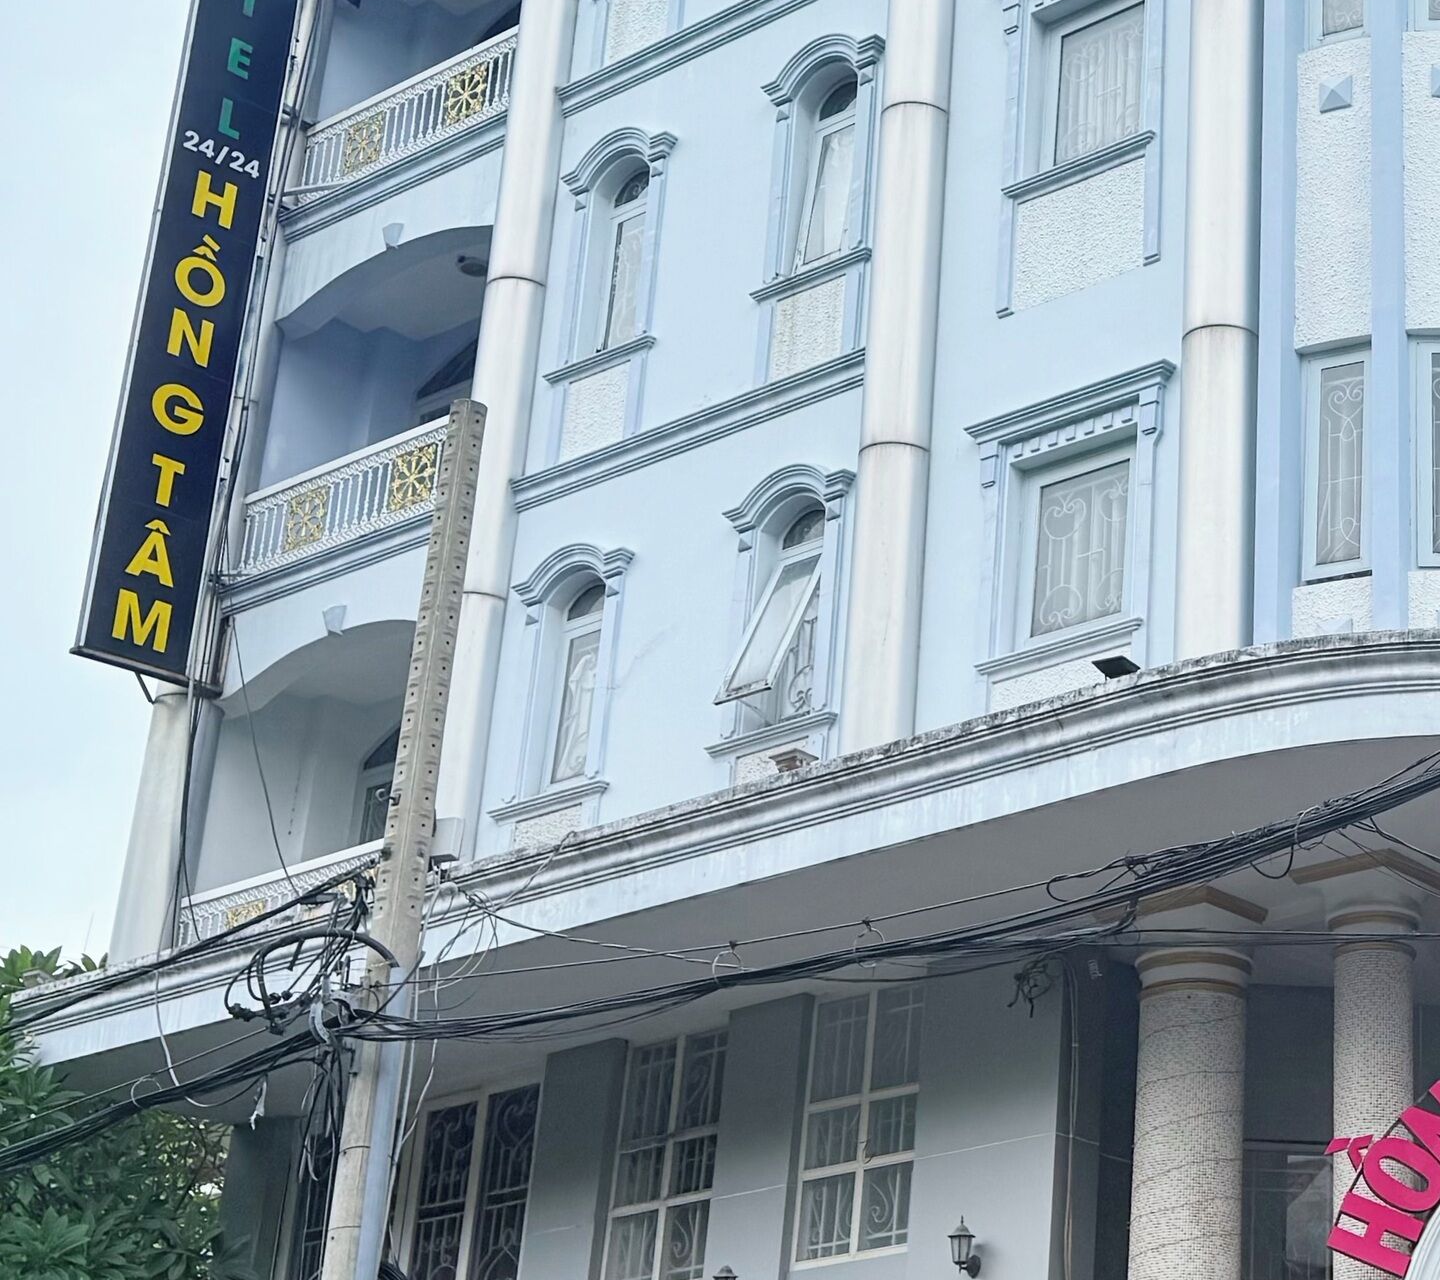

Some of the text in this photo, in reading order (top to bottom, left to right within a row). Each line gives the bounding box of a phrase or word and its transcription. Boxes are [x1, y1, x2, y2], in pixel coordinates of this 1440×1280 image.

[183, 130, 260, 179] 24/24
[112, 170, 238, 653] HỒNG TÂM
